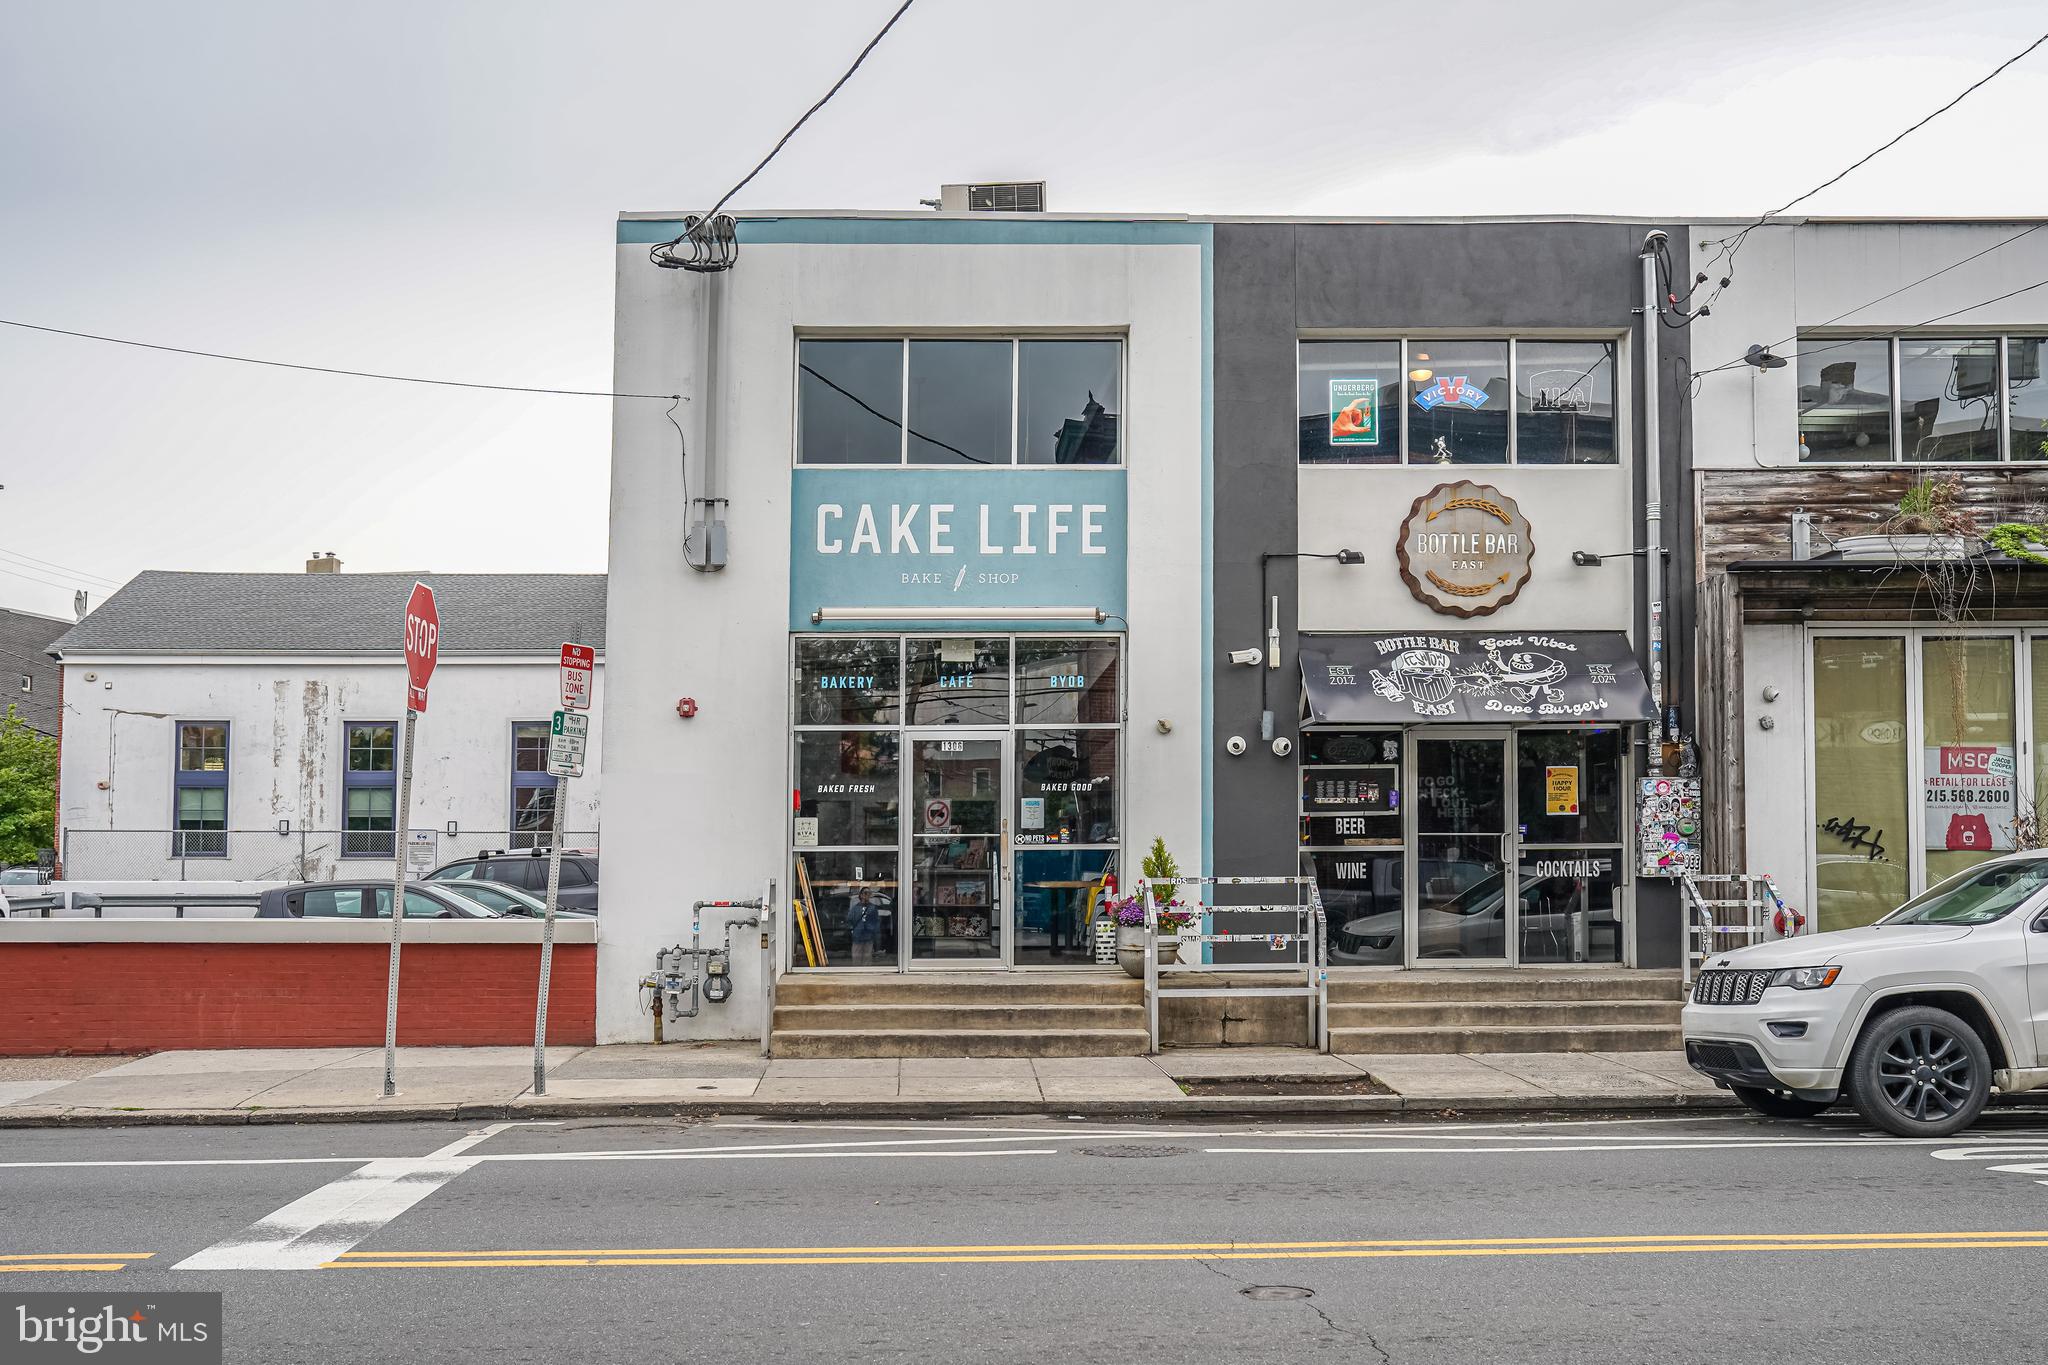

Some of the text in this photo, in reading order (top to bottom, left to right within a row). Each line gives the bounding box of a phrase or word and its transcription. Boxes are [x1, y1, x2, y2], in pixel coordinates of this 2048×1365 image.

[1423, 386, 1484, 402] VICTORY
[816, 503, 1107, 555] CAKE LIFE
[1417, 533, 1519, 555] BOTTLE BAR
[1452, 561, 1485, 571] EAST
[901, 572, 1019, 585] BAKE SHOP
[406, 613, 436, 659] STOP
[1374, 636, 1461, 656] BOTTLE BAR
[1478, 636, 1578, 652] Good Vibes
[571, 647, 582, 657] NO
[563, 656, 591, 668] STOPPING
[567, 670, 583, 682] BUS
[821, 676, 874, 689] BAKERY
[940, 672, 974, 688] CAFÉ
[1050, 675, 1085, 688] BYOB
[1329, 676, 1357, 685] 2012
[1590, 675, 1617, 684] 2024
[565, 682, 584, 695] ZONE
[1412, 699, 1457, 716] EAST
[1484, 698, 1609, 716] Dope Burgers
[554, 715, 561, 731] 3
[563, 725, 586, 737] PARKING
[1948, 752, 1988, 770] MSC
[1040, 783, 1093, 792] BAKED GOOD
[1436, 776, 1455, 787] GO
[1929, 777, 2007, 787] RETAIL FOR LEASE
[817, 784, 875, 793] BAKED FRESH
[1926, 789, 2010, 803] 215.568.2600
[1335, 818, 1366, 835] BEER
[1335, 862, 1367, 880] WINE
[1536, 860, 1600, 878] COCKTAILS
